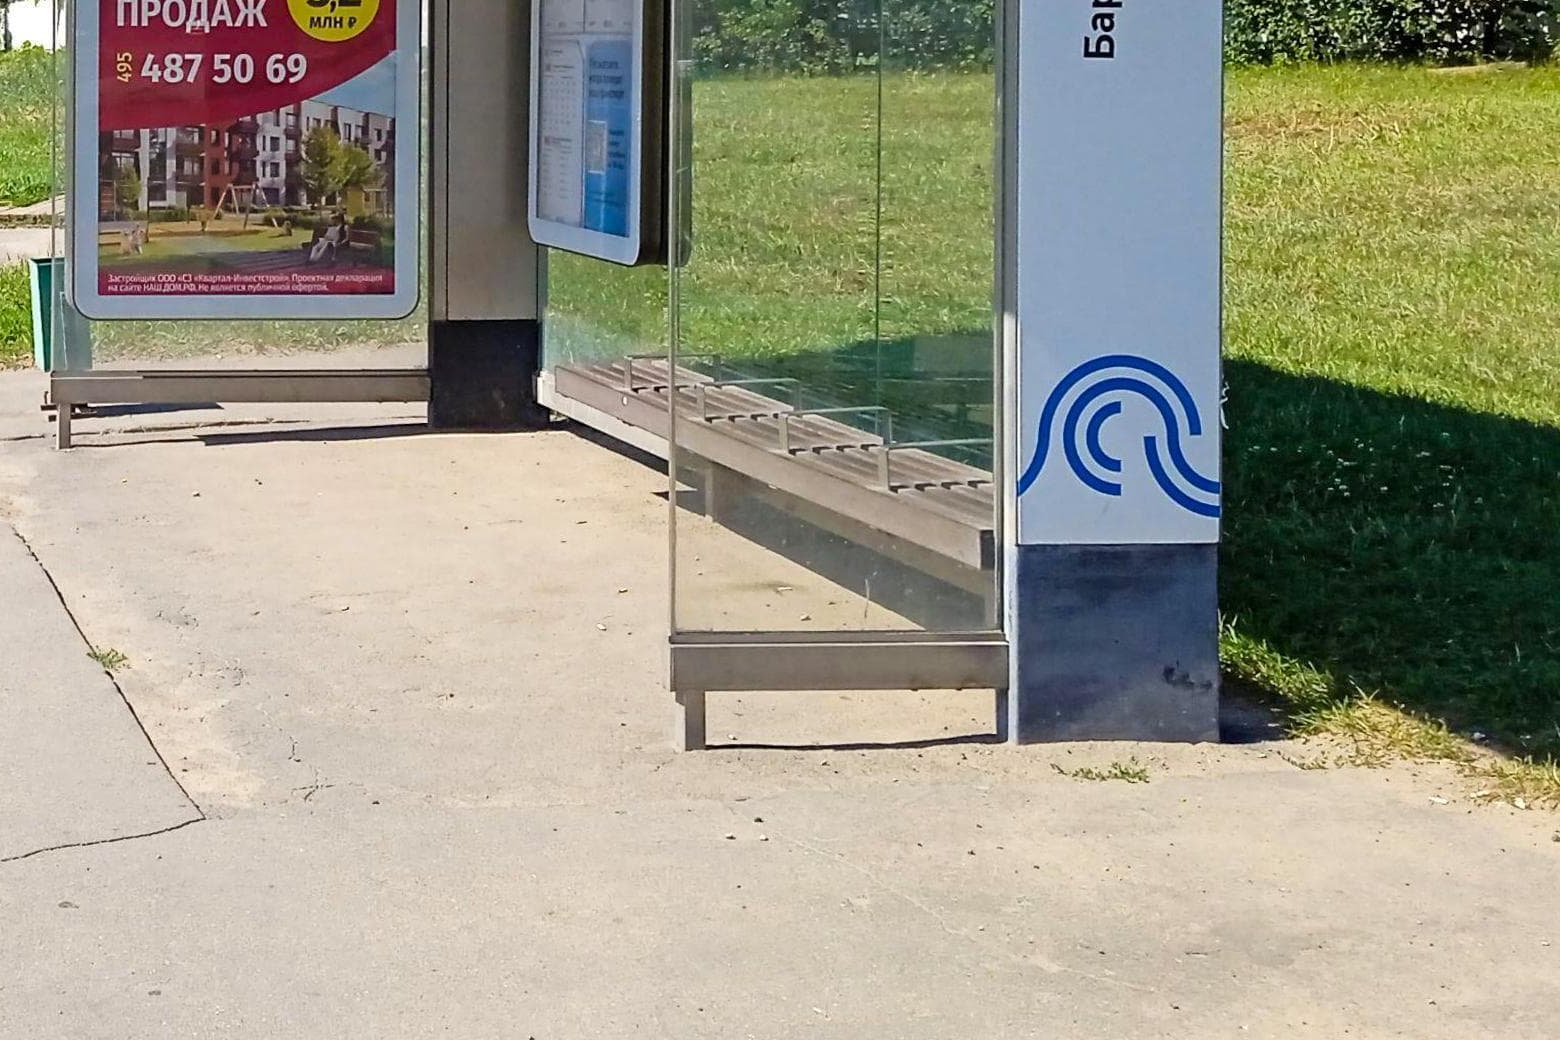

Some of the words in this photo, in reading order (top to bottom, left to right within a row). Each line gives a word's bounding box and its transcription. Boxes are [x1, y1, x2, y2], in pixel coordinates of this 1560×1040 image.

[309, 16, 344, 30] МЛН
[116, 52, 133, 83] 495
[141, 52, 204, 84] 487
[212, 53, 256, 84] 50
[265, 53, 308, 84] 69
[157, 274, 177, 283] ООО
